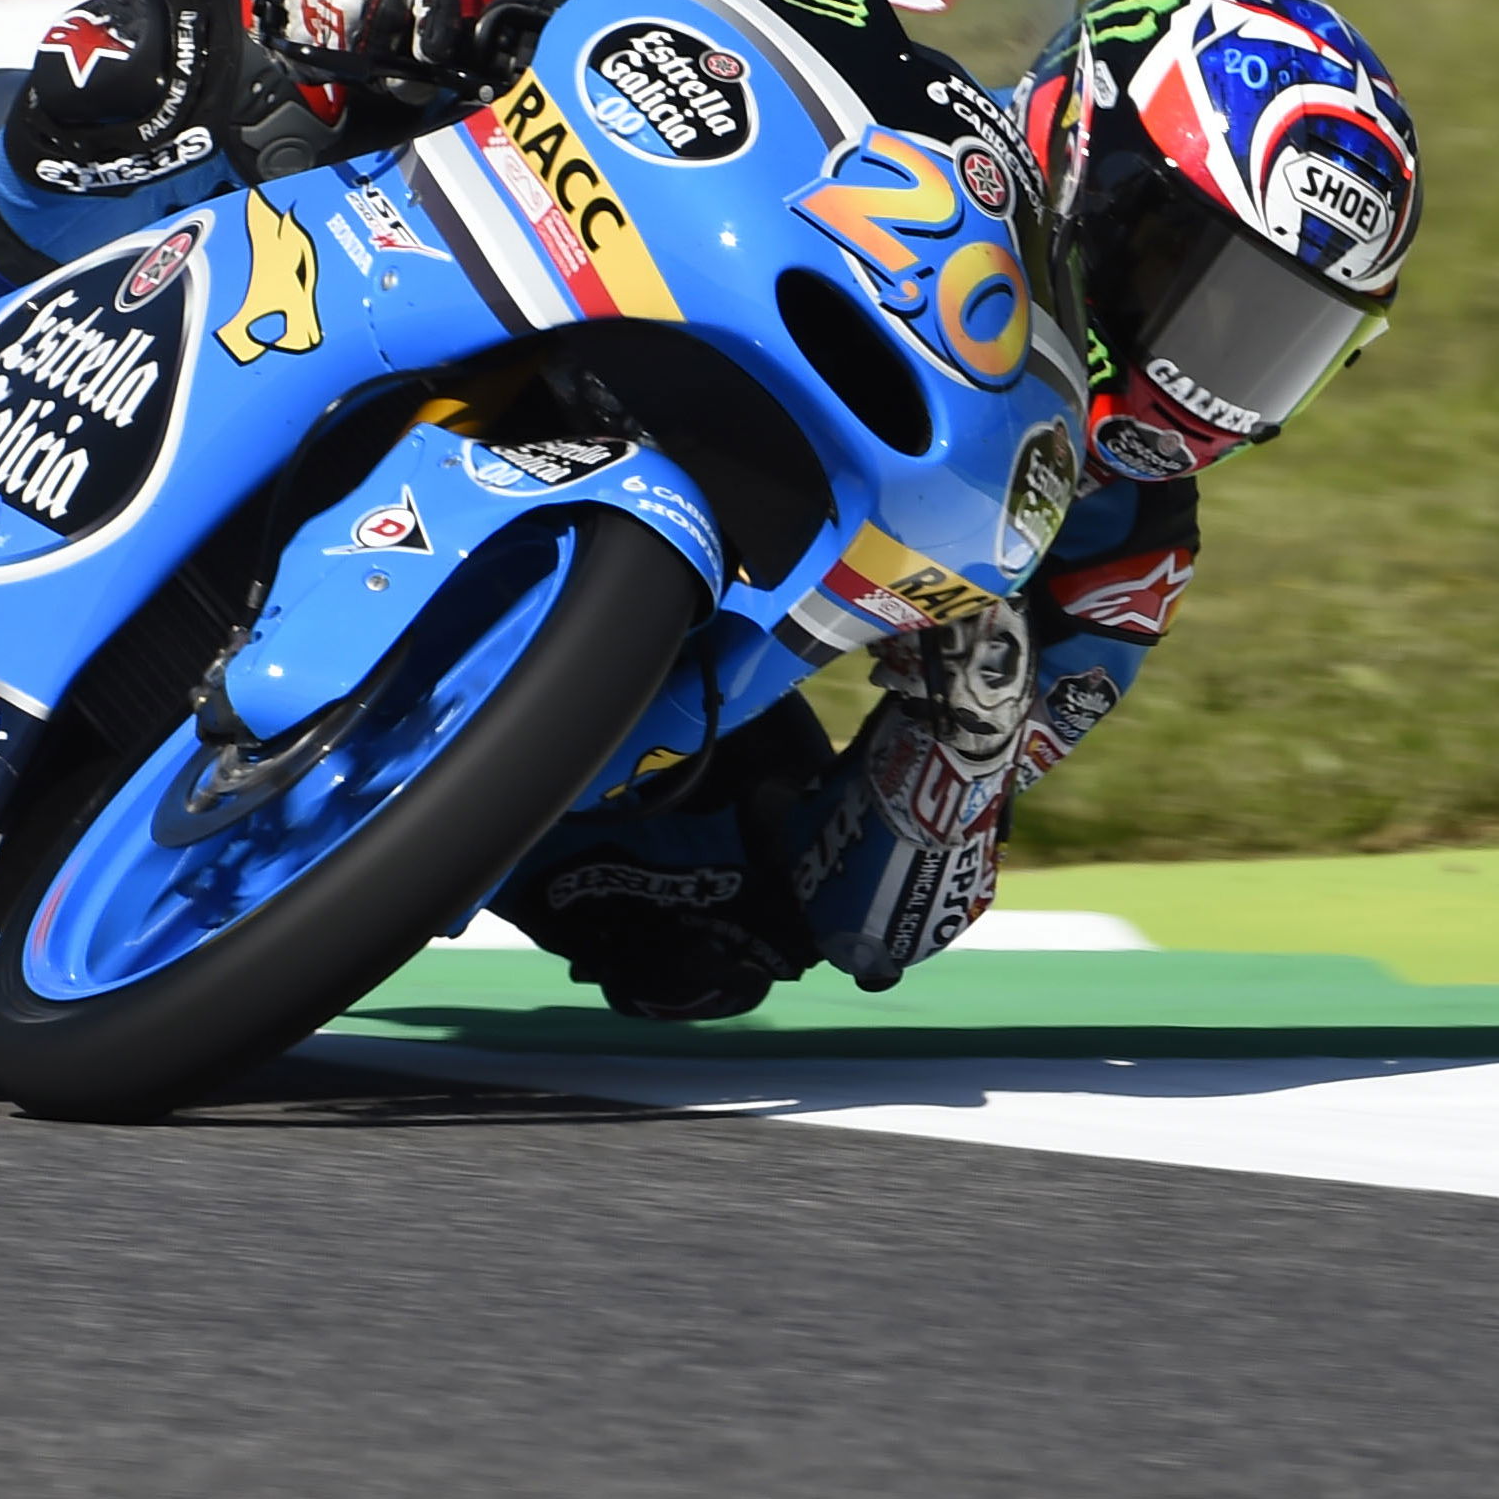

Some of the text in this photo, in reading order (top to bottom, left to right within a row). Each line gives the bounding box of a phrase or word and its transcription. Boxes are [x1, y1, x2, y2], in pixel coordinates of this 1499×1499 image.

[137, 78, 188, 142] RACING
[600, 49, 697, 149] Galicia
[628, 30, 737, 137] Estrella
[504, 81, 625, 253] RACC
[947, 75, 1045, 197] HONDA
[1300, 166, 1382, 235] SHOEI
[1146, 358, 1261, 434] GALFER
[931, 843, 980, 946] EPSO
